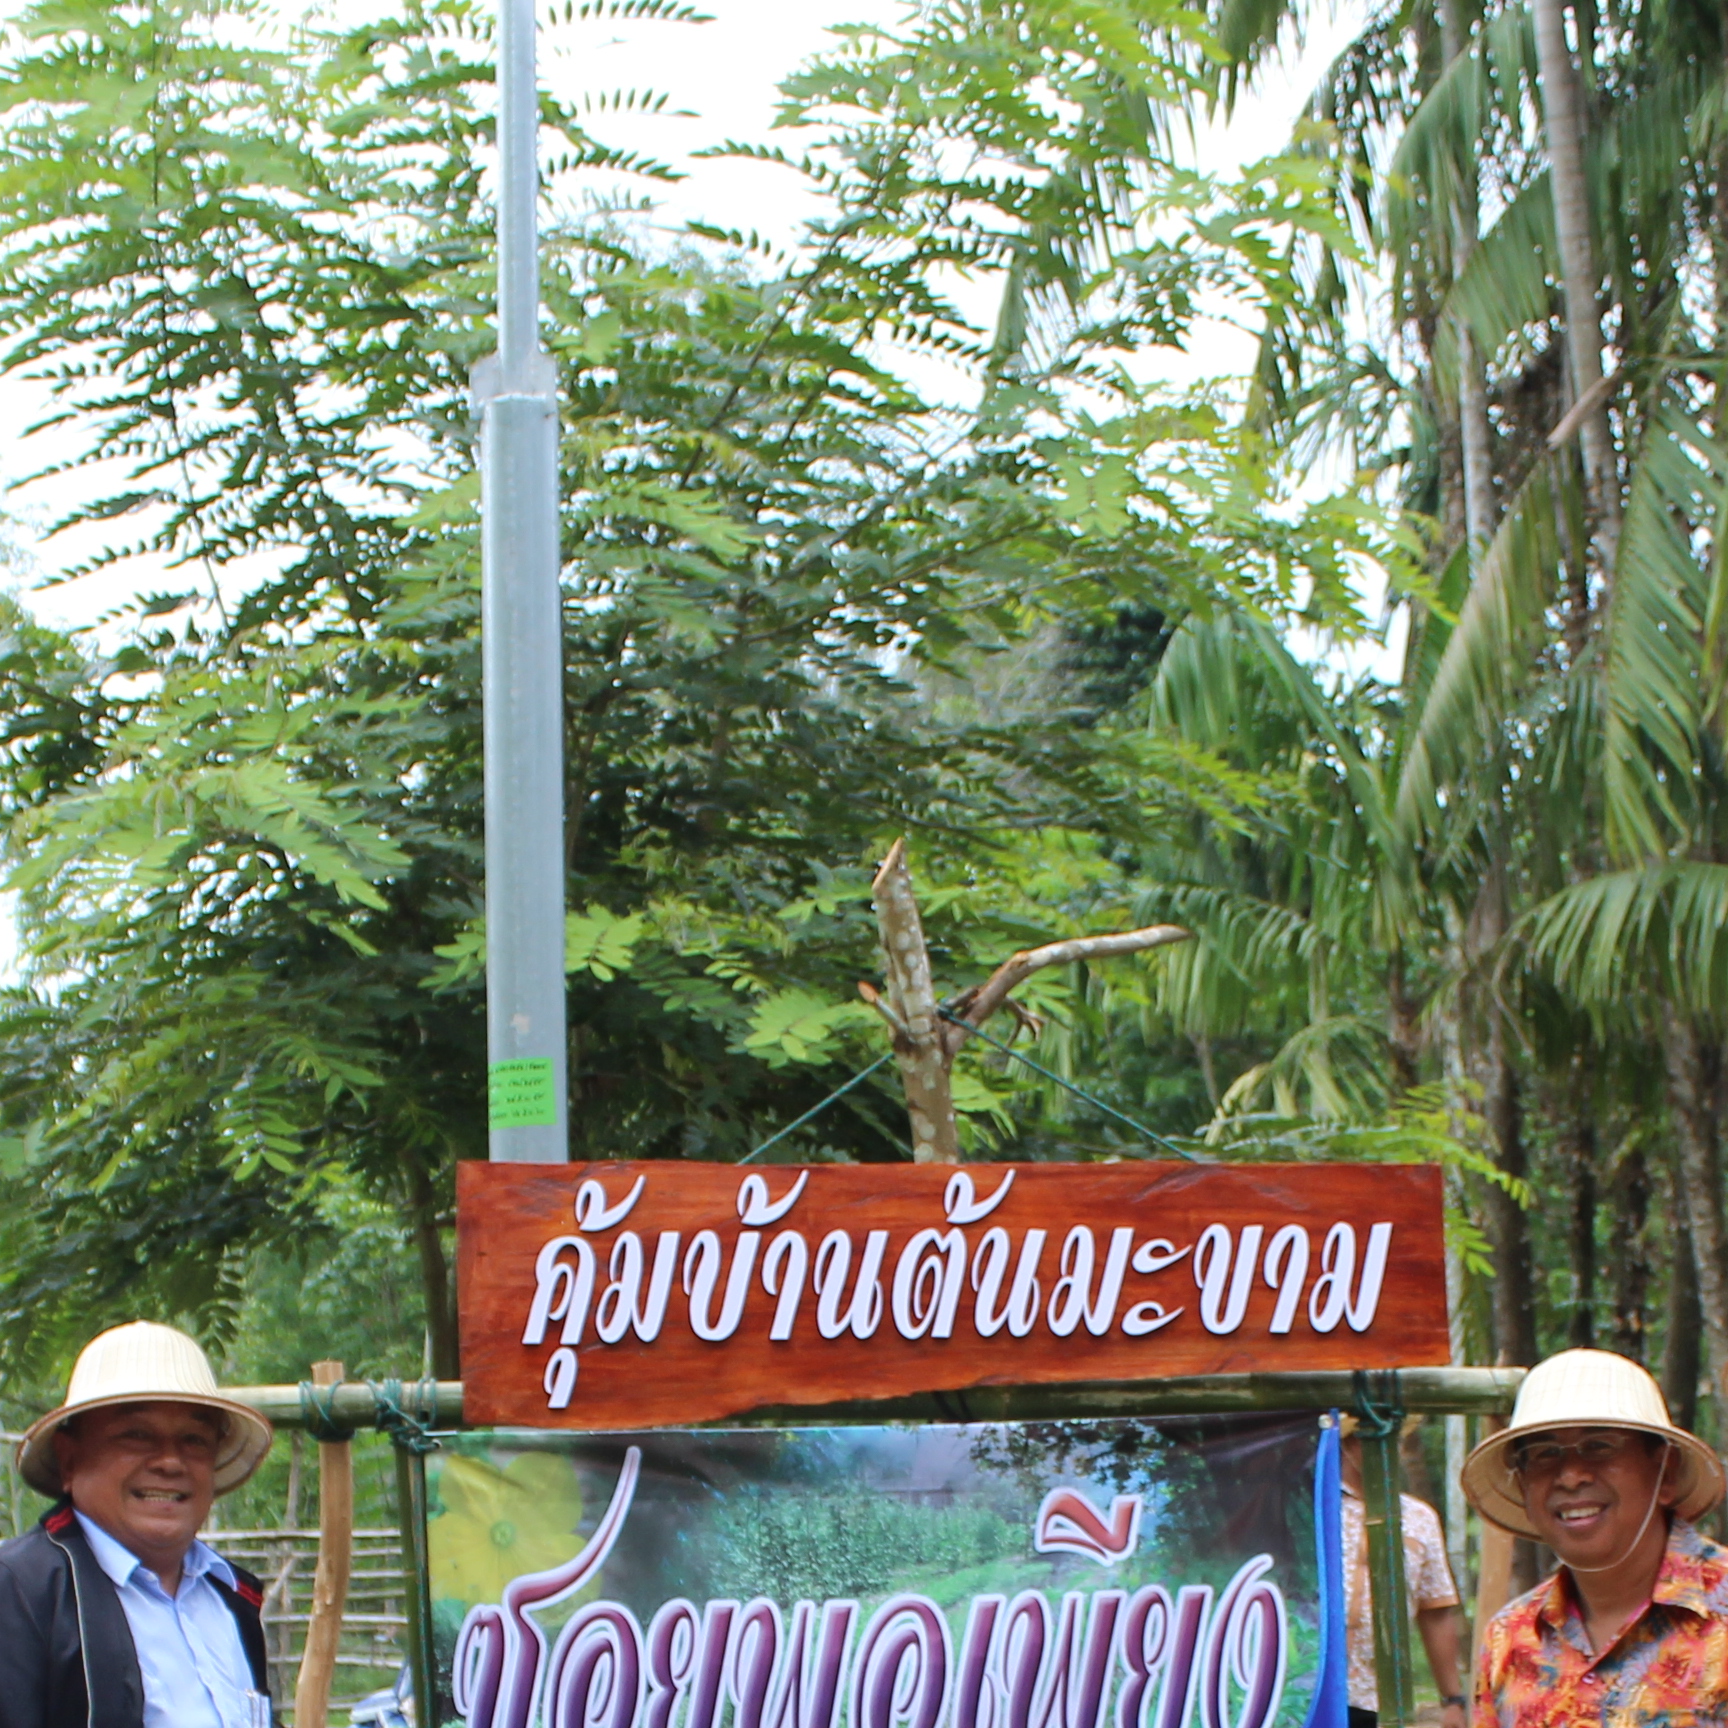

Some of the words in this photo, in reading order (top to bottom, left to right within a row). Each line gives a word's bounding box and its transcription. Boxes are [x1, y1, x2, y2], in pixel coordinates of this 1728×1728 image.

[523, 1169, 1393, 1408] คุ้มบ้านต้นมะขาม
